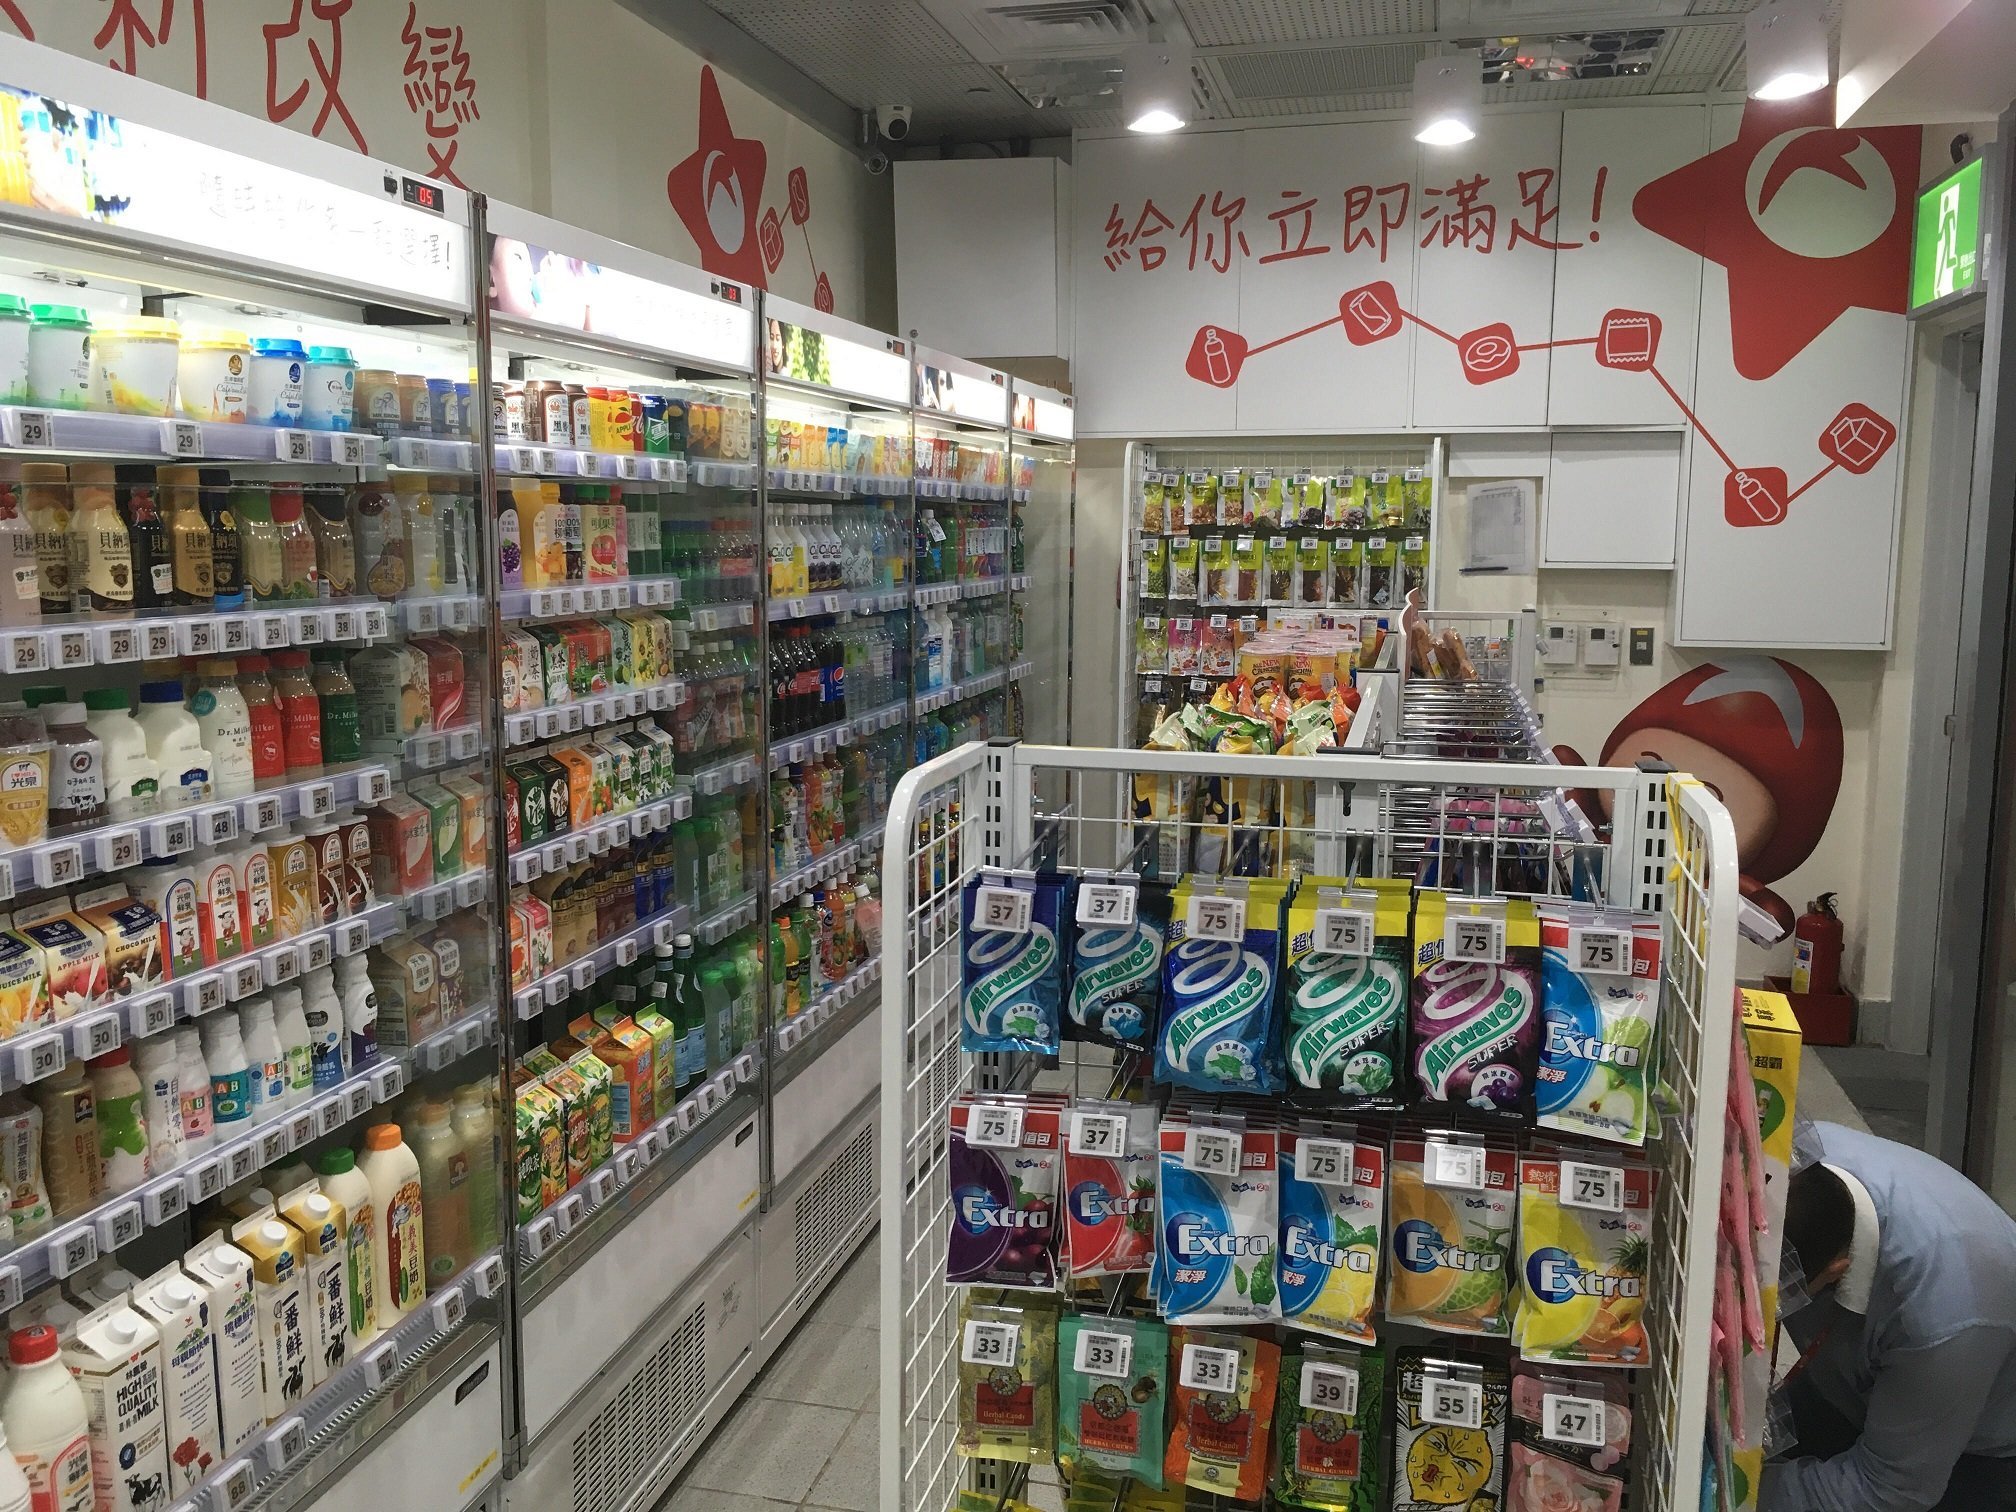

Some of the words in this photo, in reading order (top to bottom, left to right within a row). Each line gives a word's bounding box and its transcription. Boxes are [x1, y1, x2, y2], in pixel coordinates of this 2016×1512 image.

[419, 187, 435, 205] 05
[1104, 166, 1608, 274] 給你立即滿足!
[24, 424, 42, 440] 29
[179, 435, 193, 448] 29
[292, 442, 304, 455] 29
[346, 447, 358, 458] 29
[303, 624, 315, 636] 38
[338, 621, 349, 633] 38
[369, 619, 379, 631] 38
[193, 633, 208, 646] 29
[228, 630, 242, 643] 29
[267, 628, 280, 640] 29
[114, 639, 129, 653] 29
[152, 636, 166, 650] 29
[18, 648, 35, 662] 29
[65, 644, 81, 658] 29
[1262, 659, 1280, 667] NEW
[10, 776, 37, 788] 光泉
[372, 781, 384, 794] 38
[315, 795, 327, 808] 38
[261, 810, 274, 823] 38
[215, 821, 228, 834] 48
[169, 832, 184, 846] 48
[115, 845, 130, 860] 29
[54, 860, 71, 875] 37
[991, 905, 1013, 921] 37
[1093, 900, 1117, 914] 37
[1203, 914, 1227, 930] 75
[115, 941, 139, 953] CHOCO
[139, 934, 157, 946] MILK
[351, 934, 362, 946] 29
[1331, 928, 1356, 944] 75
[1461, 935, 1487, 951] 75
[57, 959, 81, 971] APPLE
[82, 952, 100, 964] MILK
[312, 949, 323, 961] 29
[1586, 946, 1613, 963] 75
[278, 961, 291, 974] 34
[22, 971, 42, 984] MILK
[240, 975, 253, 988] 34
[969, 935, 1051, 1028] Airwaves
[1074, 938, 1154, 1016] Airwaves
[202, 992, 216, 1005] 34
[1101, 980, 1145, 1004] SUPER
[149, 1011, 164, 1025] 30
[1169, 966, 1263, 1065] Airwaves
[1299, 976, 1392, 1080] Airwaves
[94, 1032, 110, 1048] 30
[1339, 1021, 1390, 1060] SUPER
[1424, 986, 1523, 1092] Airwaves
[1543, 1020, 1640, 1067] Extra
[1467, 1033, 1519, 1071] SUPER
[35, 1056, 52, 1070] 30
[217, 1080, 239, 1094] AB
[385, 1080, 396, 1092] 27
[353, 1096, 364, 1109] 27
[326, 1111, 337, 1124] 27
[296, 1127, 308, 1141] 27
[983, 1121, 1005, 1136] 75
[1085, 1130, 1109, 1145] 37
[265, 1144, 279, 1156] 27
[1200, 1147, 1224, 1163] 75
[233, 1158, 248, 1172] 27
[1312, 1157, 1336, 1173] 75
[1442, 1160, 1467, 1177] 75
[202, 1177, 215, 1191] 17
[1578, 1180, 1605, 1198] 75
[162, 1198, 177, 1212] 24
[1080, 1190, 1155, 1217] Extra
[961, 1195, 1049, 1229] Extra
[116, 1223, 131, 1237] 29
[1178, 1223, 1269, 1257] Extra
[69, 1247, 85, 1263] 29
[1285, 1224, 1372, 1274] Extra
[1405, 1230, 1501, 1272] Extra
[488, 1270, 498, 1283] 40
[1174, 1269, 1207, 1284] 潔淨
[1540, 1259, 1641, 1298] Extra
[327, 1260, 345, 1330] 一番鮮
[282, 1289, 302, 1361] 一番鮮
[977, 1338, 1000, 1354] 33
[1090, 1347, 1114, 1364] 33
[1196, 1363, 1221, 1379] 33
[116, 1377, 142, 1403] HIGH
[1316, 1384, 1341, 1401] 39
[118, 1381, 158, 1417] QUALITY
[1438, 1396, 1464, 1414] 55
[137, 1396, 159, 1421] MILK
[1560, 1413, 1587, 1431] 47
[285, 1436, 297, 1454] 87
[1219, 1441, 1240, 1450] Candy
[231, 1481, 246, 1498] 88
